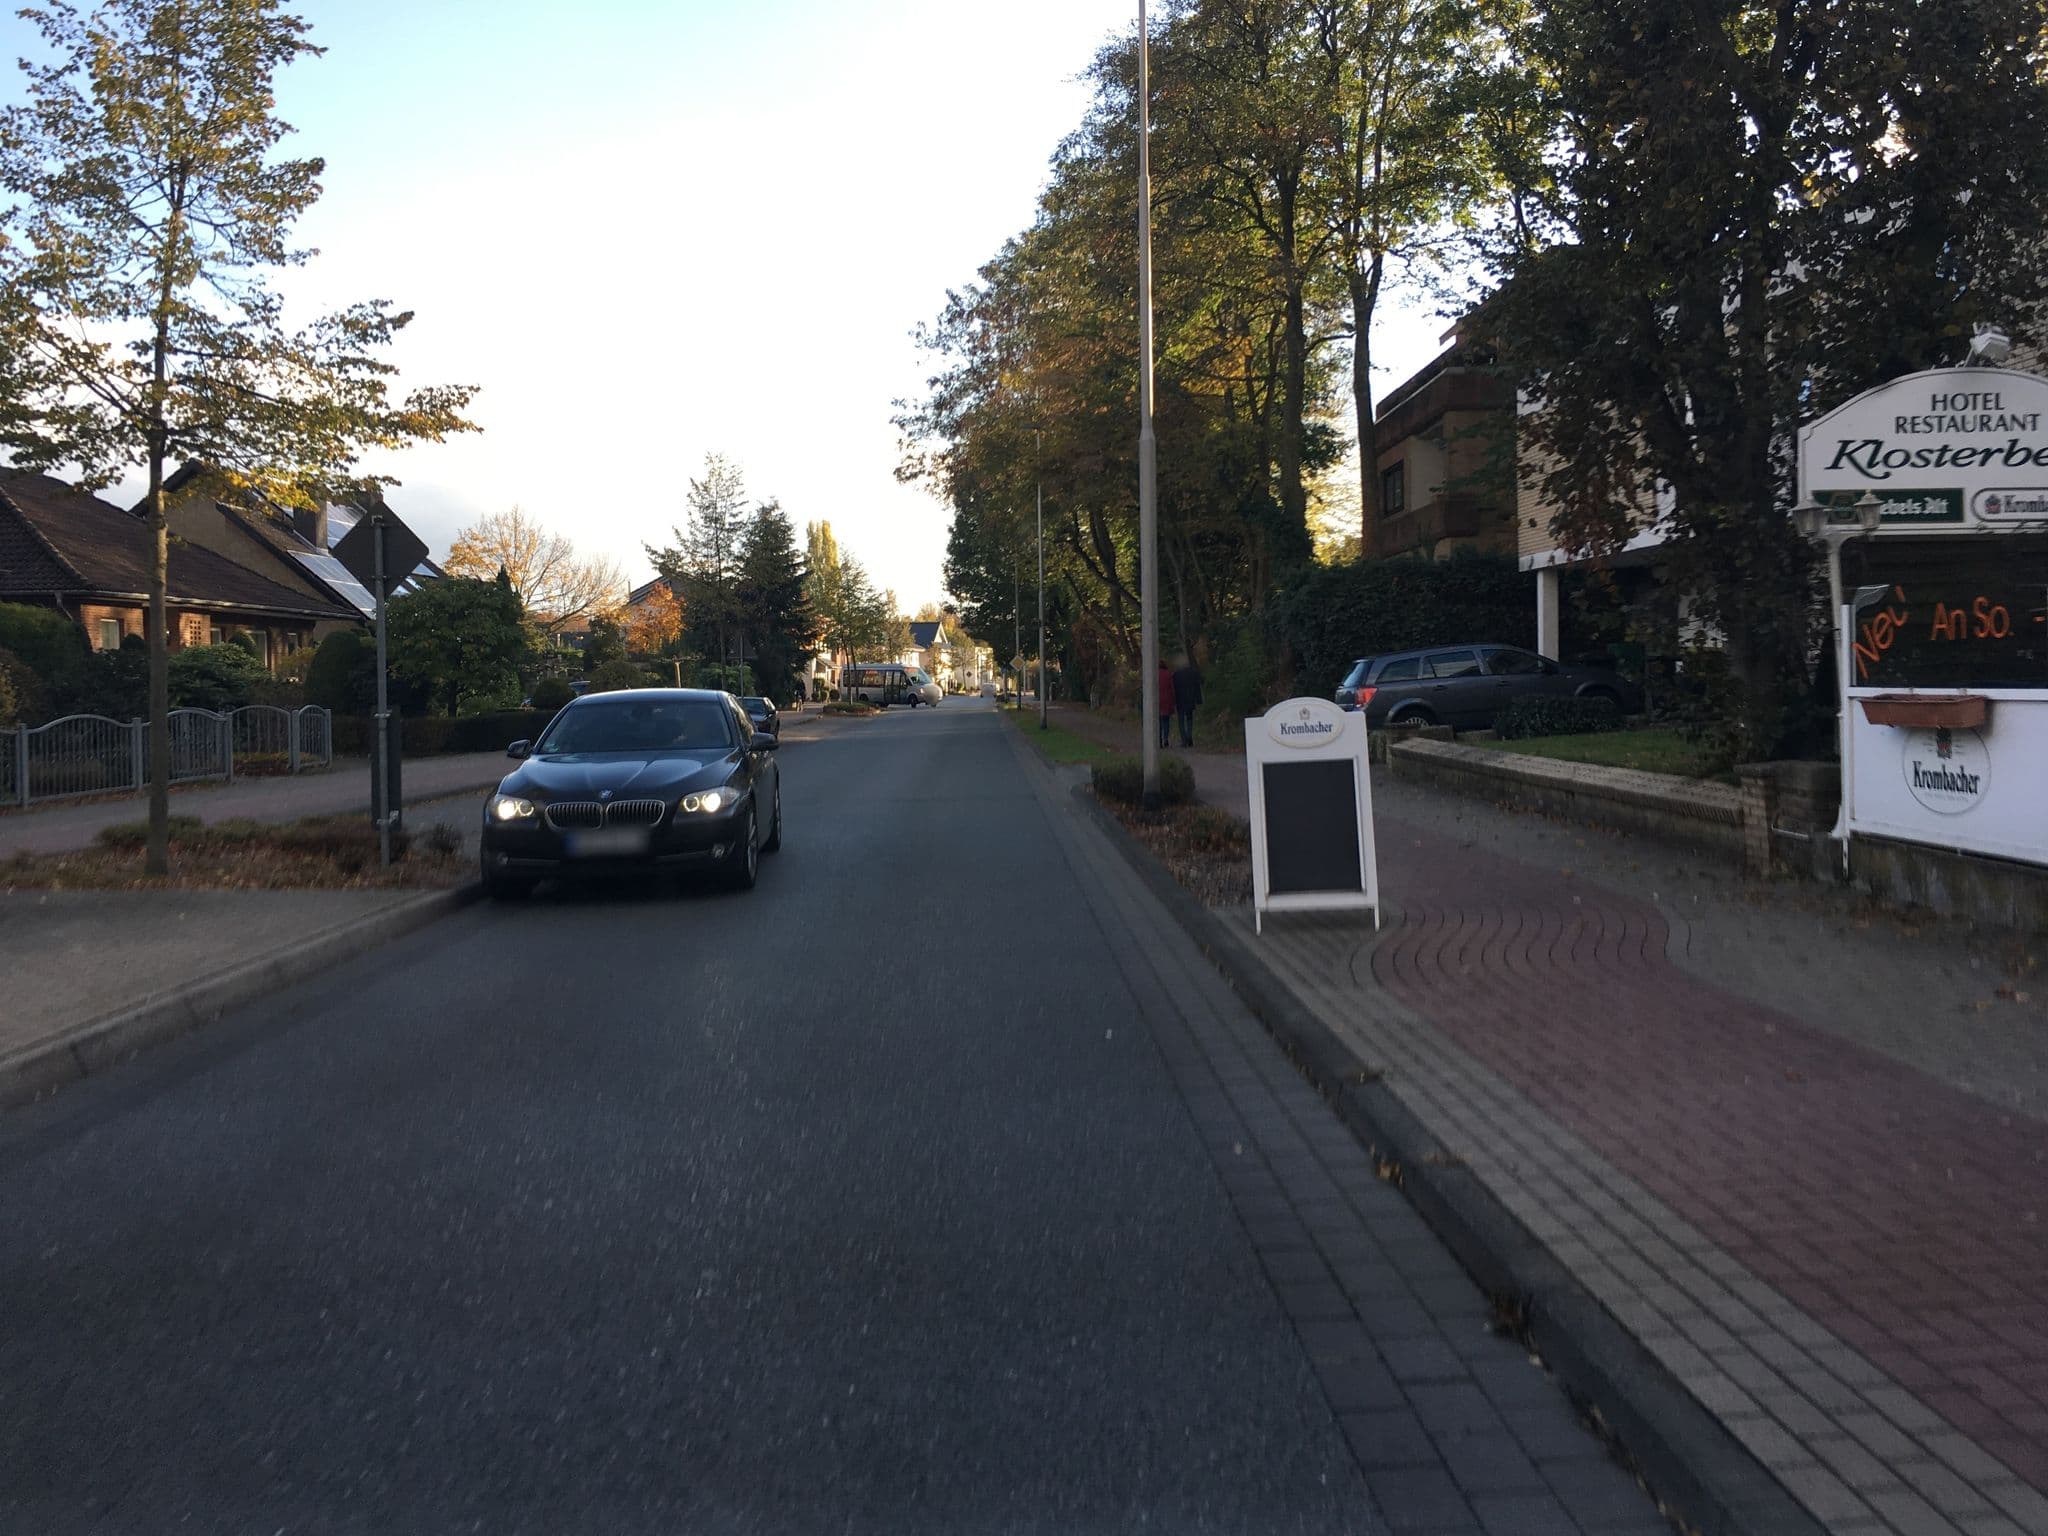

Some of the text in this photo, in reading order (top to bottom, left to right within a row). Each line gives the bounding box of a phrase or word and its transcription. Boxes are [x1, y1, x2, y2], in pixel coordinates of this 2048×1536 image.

[1931, 392, 2006, 412] HOTEL
[1894, 413, 2042, 434] RESTAURANT
[1280, 721, 1334, 736] Krombacher
[1912, 760, 1981, 795] Krombacher
